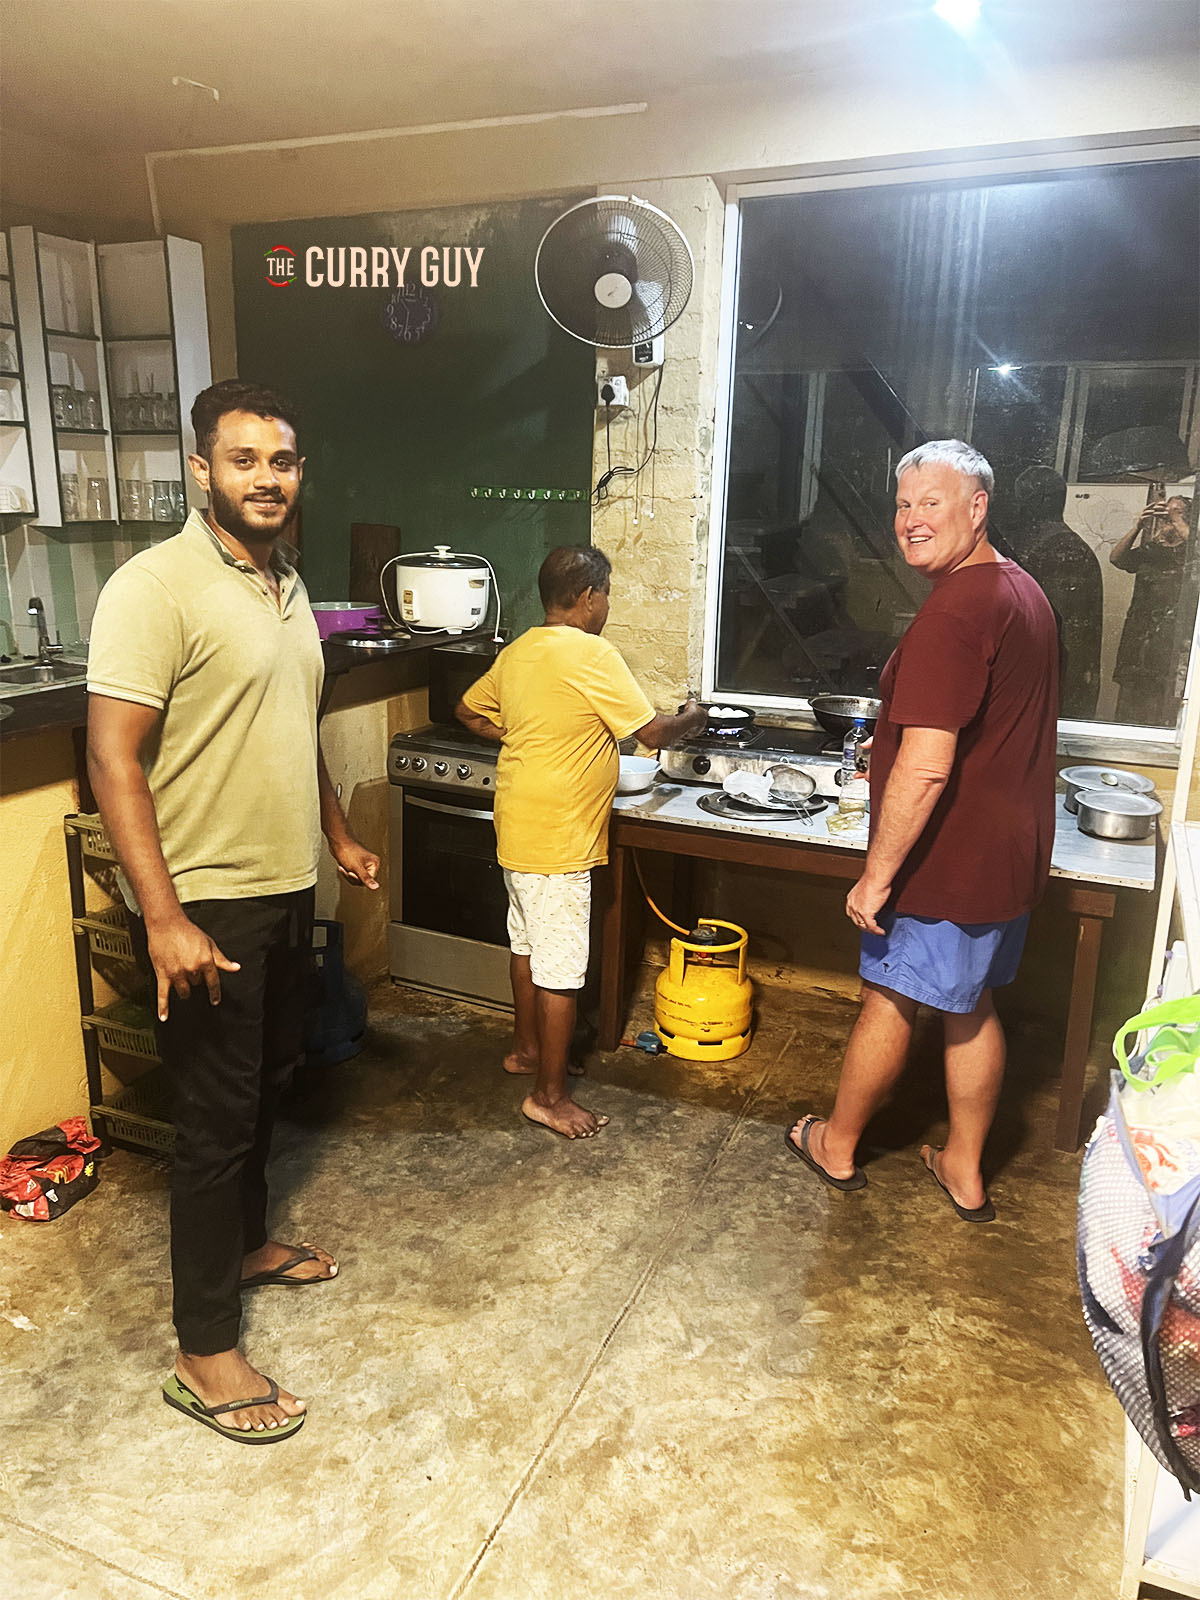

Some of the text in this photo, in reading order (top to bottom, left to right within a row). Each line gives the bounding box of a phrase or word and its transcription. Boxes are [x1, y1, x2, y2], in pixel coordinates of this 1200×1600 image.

[405, 283, 416, 297] 12
[386, 304, 394, 318] 9
[389, 317, 398, 330] 8
